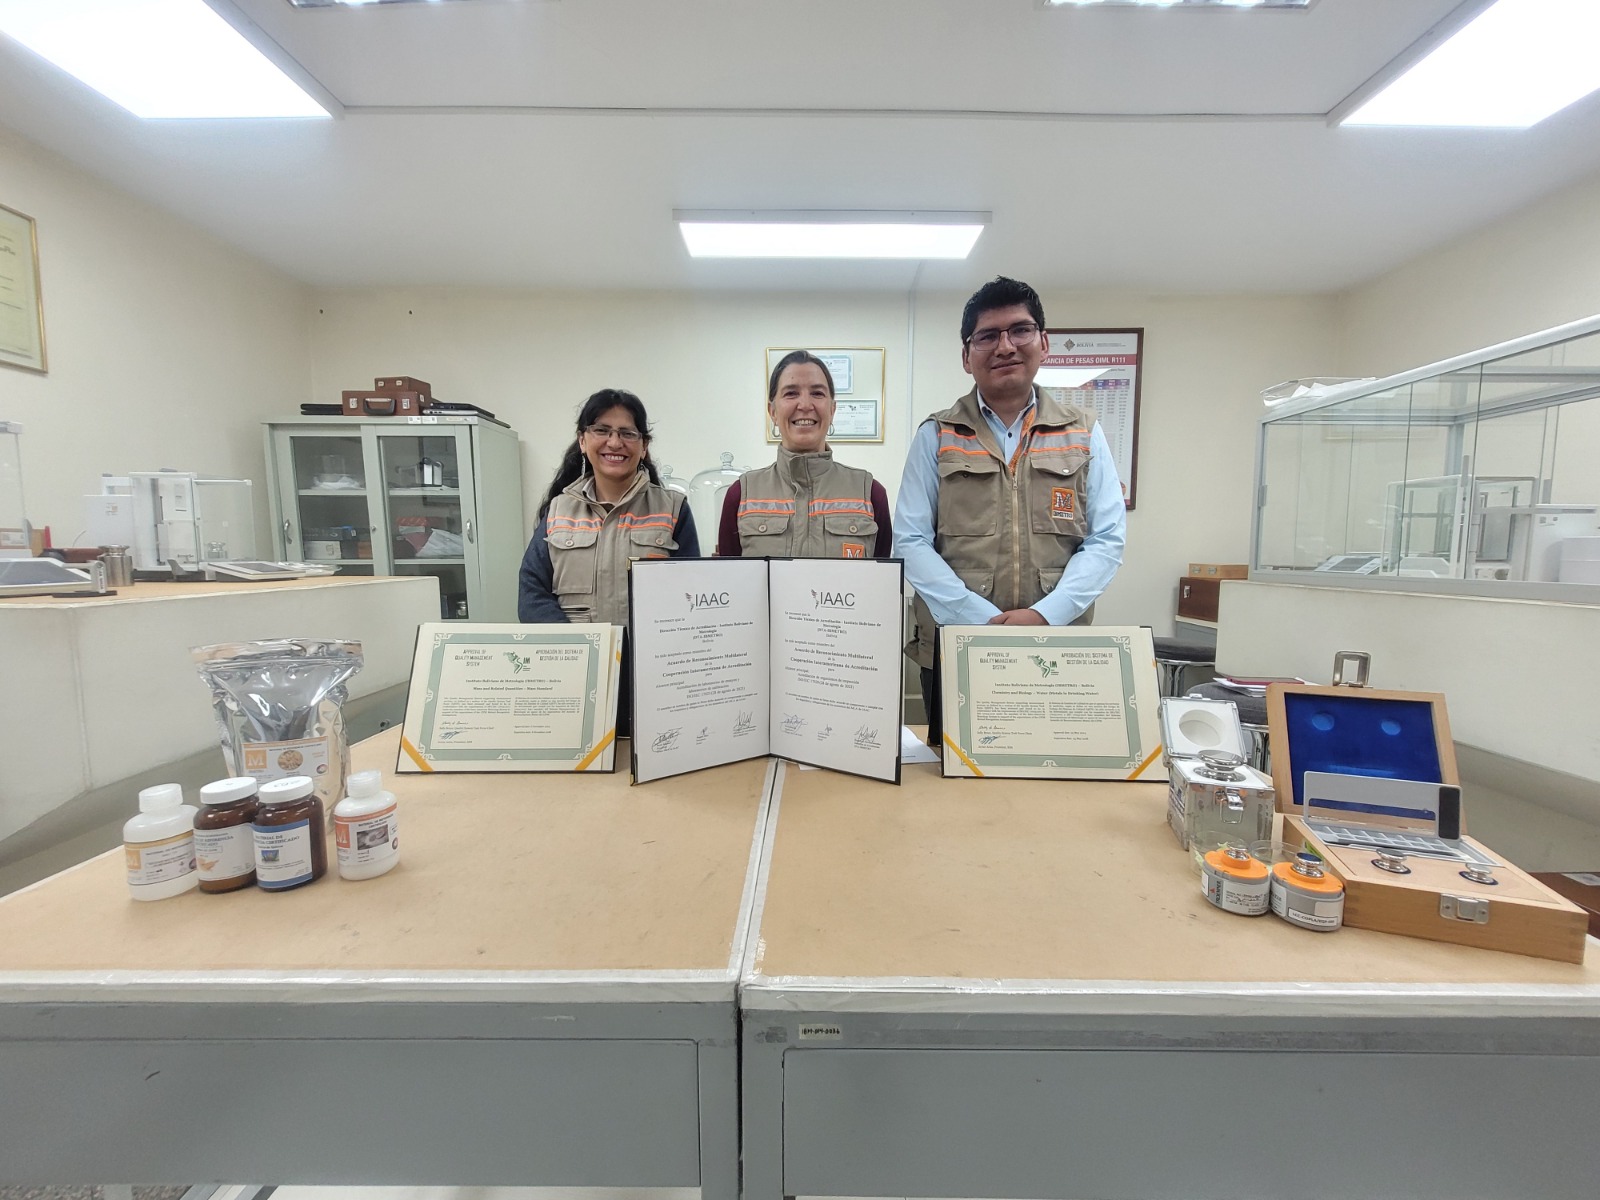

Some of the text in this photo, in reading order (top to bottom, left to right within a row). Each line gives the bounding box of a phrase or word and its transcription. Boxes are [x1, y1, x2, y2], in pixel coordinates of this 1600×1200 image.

[1055, 492, 1072, 508] M
[695, 592, 729, 607] IAAC
[820, 592, 855, 606] IAAC
[248, 753, 264, 766] M
